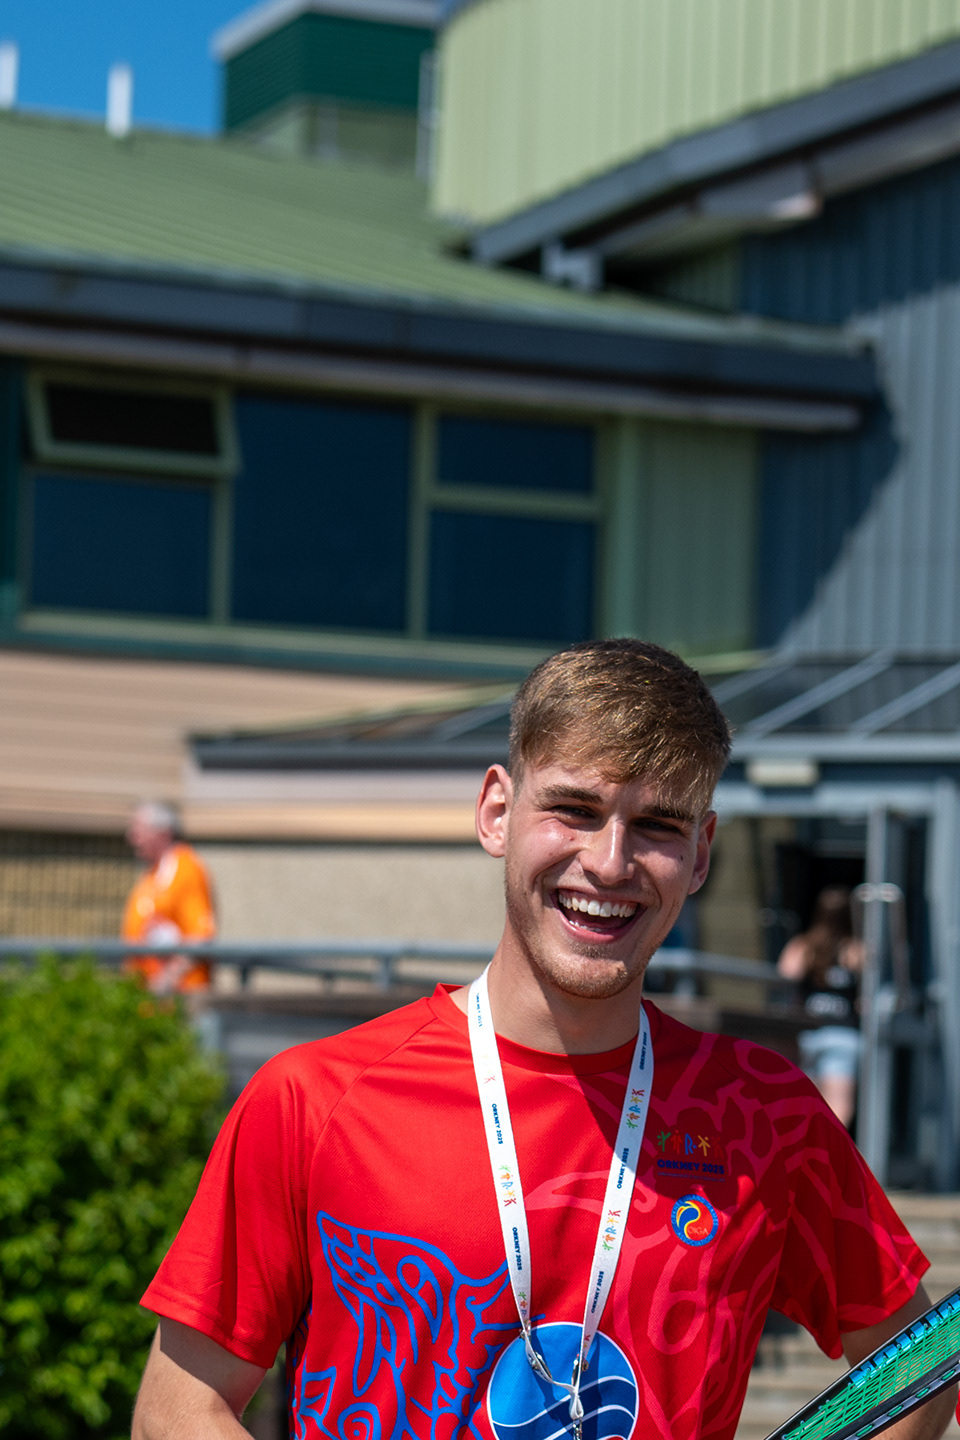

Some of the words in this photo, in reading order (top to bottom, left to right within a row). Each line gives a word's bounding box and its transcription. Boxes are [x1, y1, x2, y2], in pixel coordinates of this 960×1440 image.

[492, 1103, 501, 1128] ORKNEY
[616, 1163, 626, 1189] ORKNEY
[657, 1159, 700, 1171] ORKNEY
[702, 1162, 725, 1174] 2025
[512, 1226, 521, 1253] ORKNEY
